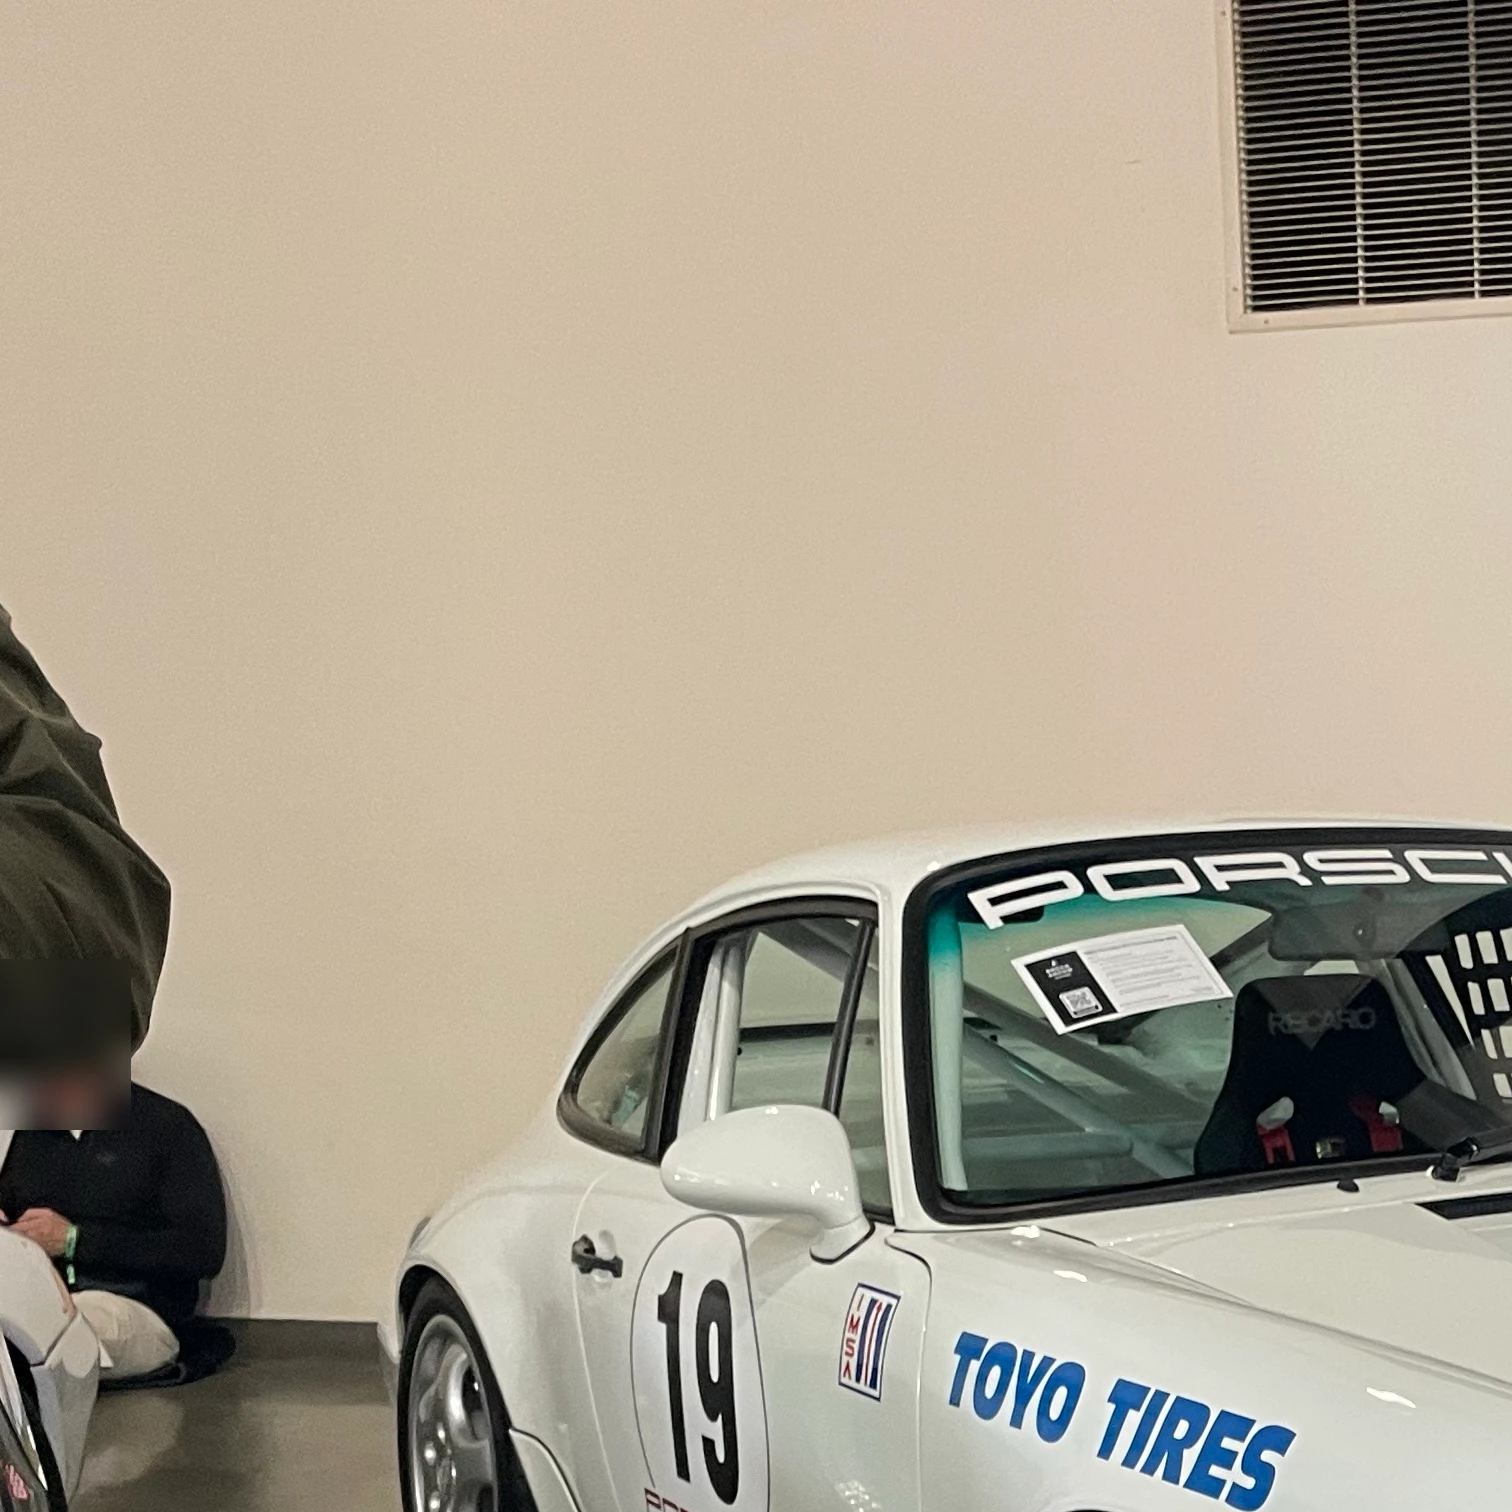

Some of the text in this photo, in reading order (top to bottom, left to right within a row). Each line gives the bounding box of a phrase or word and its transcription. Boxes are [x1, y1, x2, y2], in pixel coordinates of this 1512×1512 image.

[1267, 1006, 1377, 1036] RECARO
[657, 1270, 740, 1505] 19
[842, 1293, 865, 1381] IMSA
[948, 1331, 1297, 1512] TOYO TIRES
